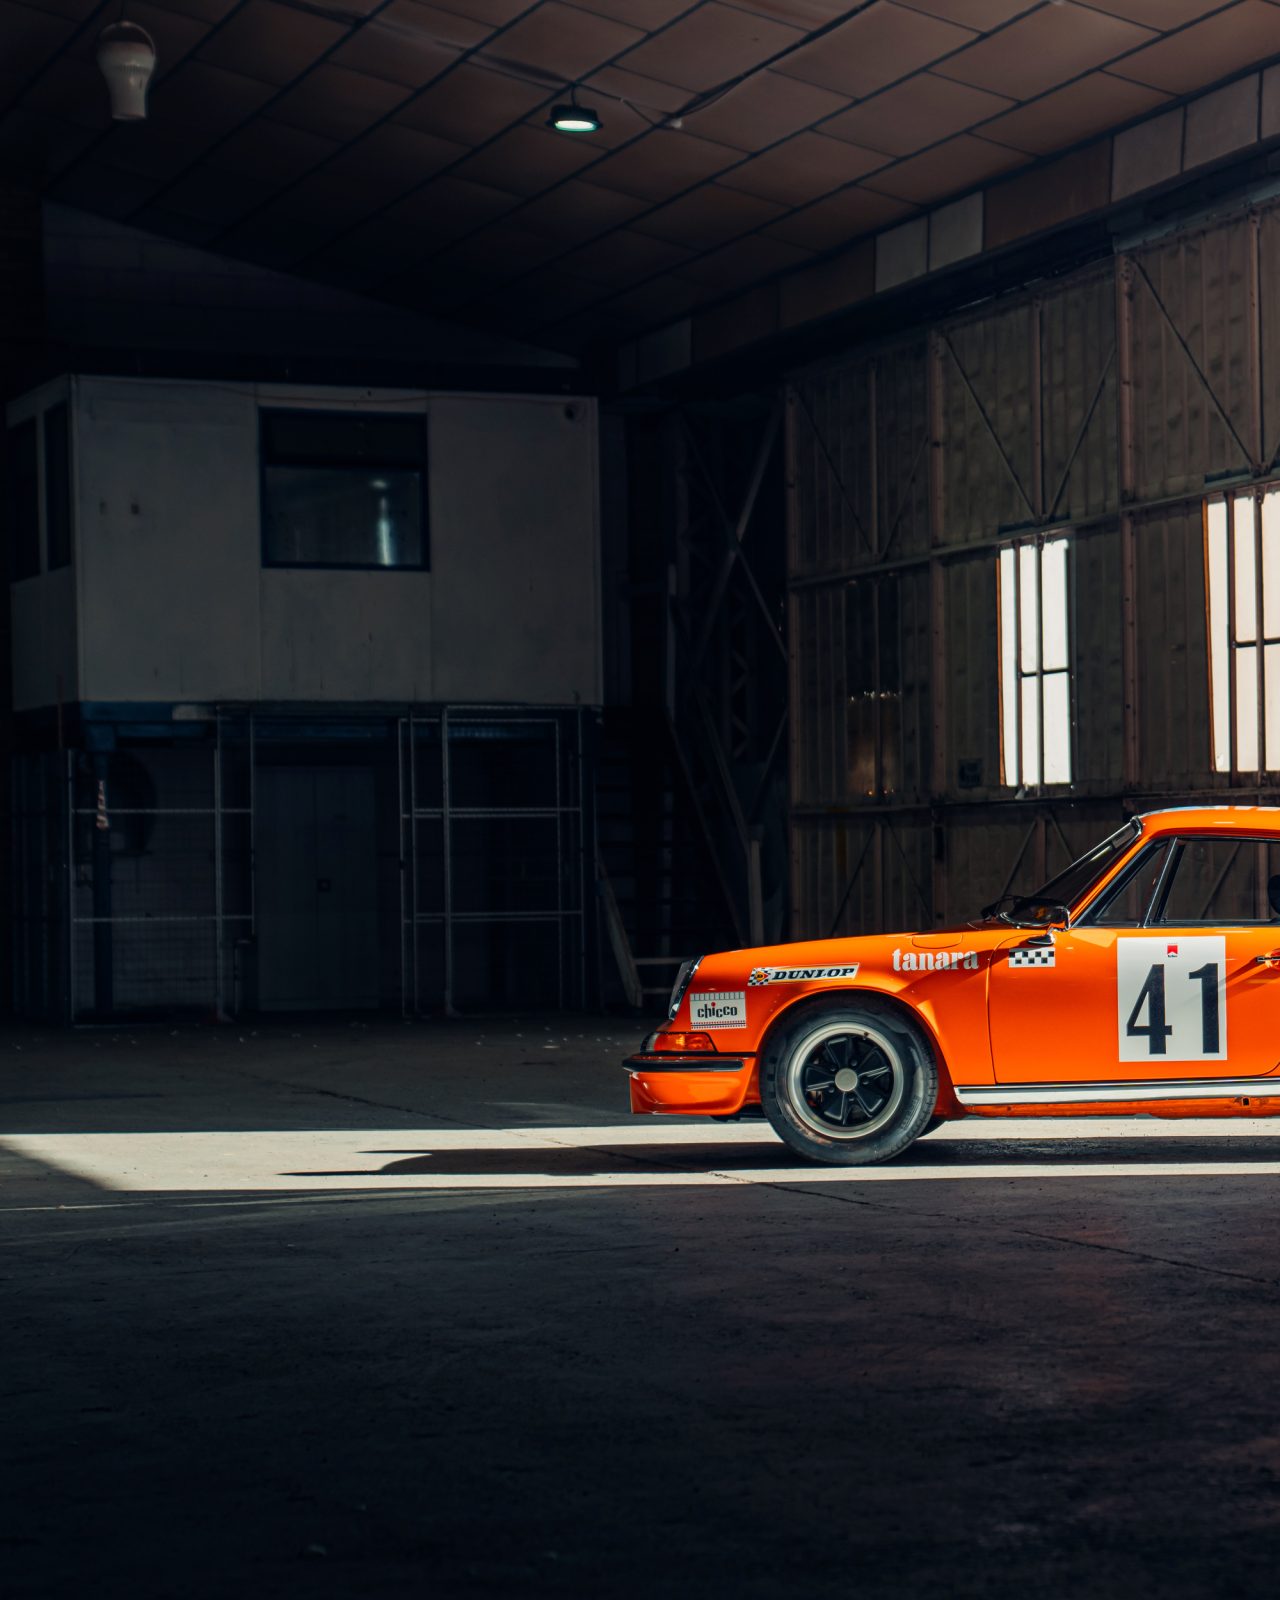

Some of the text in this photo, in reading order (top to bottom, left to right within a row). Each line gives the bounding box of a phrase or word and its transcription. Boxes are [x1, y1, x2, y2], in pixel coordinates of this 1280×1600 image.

[891, 948, 979, 972] tanara
[772, 967, 855, 981] DUNLOP
[697, 1001, 738, 1019] chicco
[1126, 962, 1220, 1055] 41
